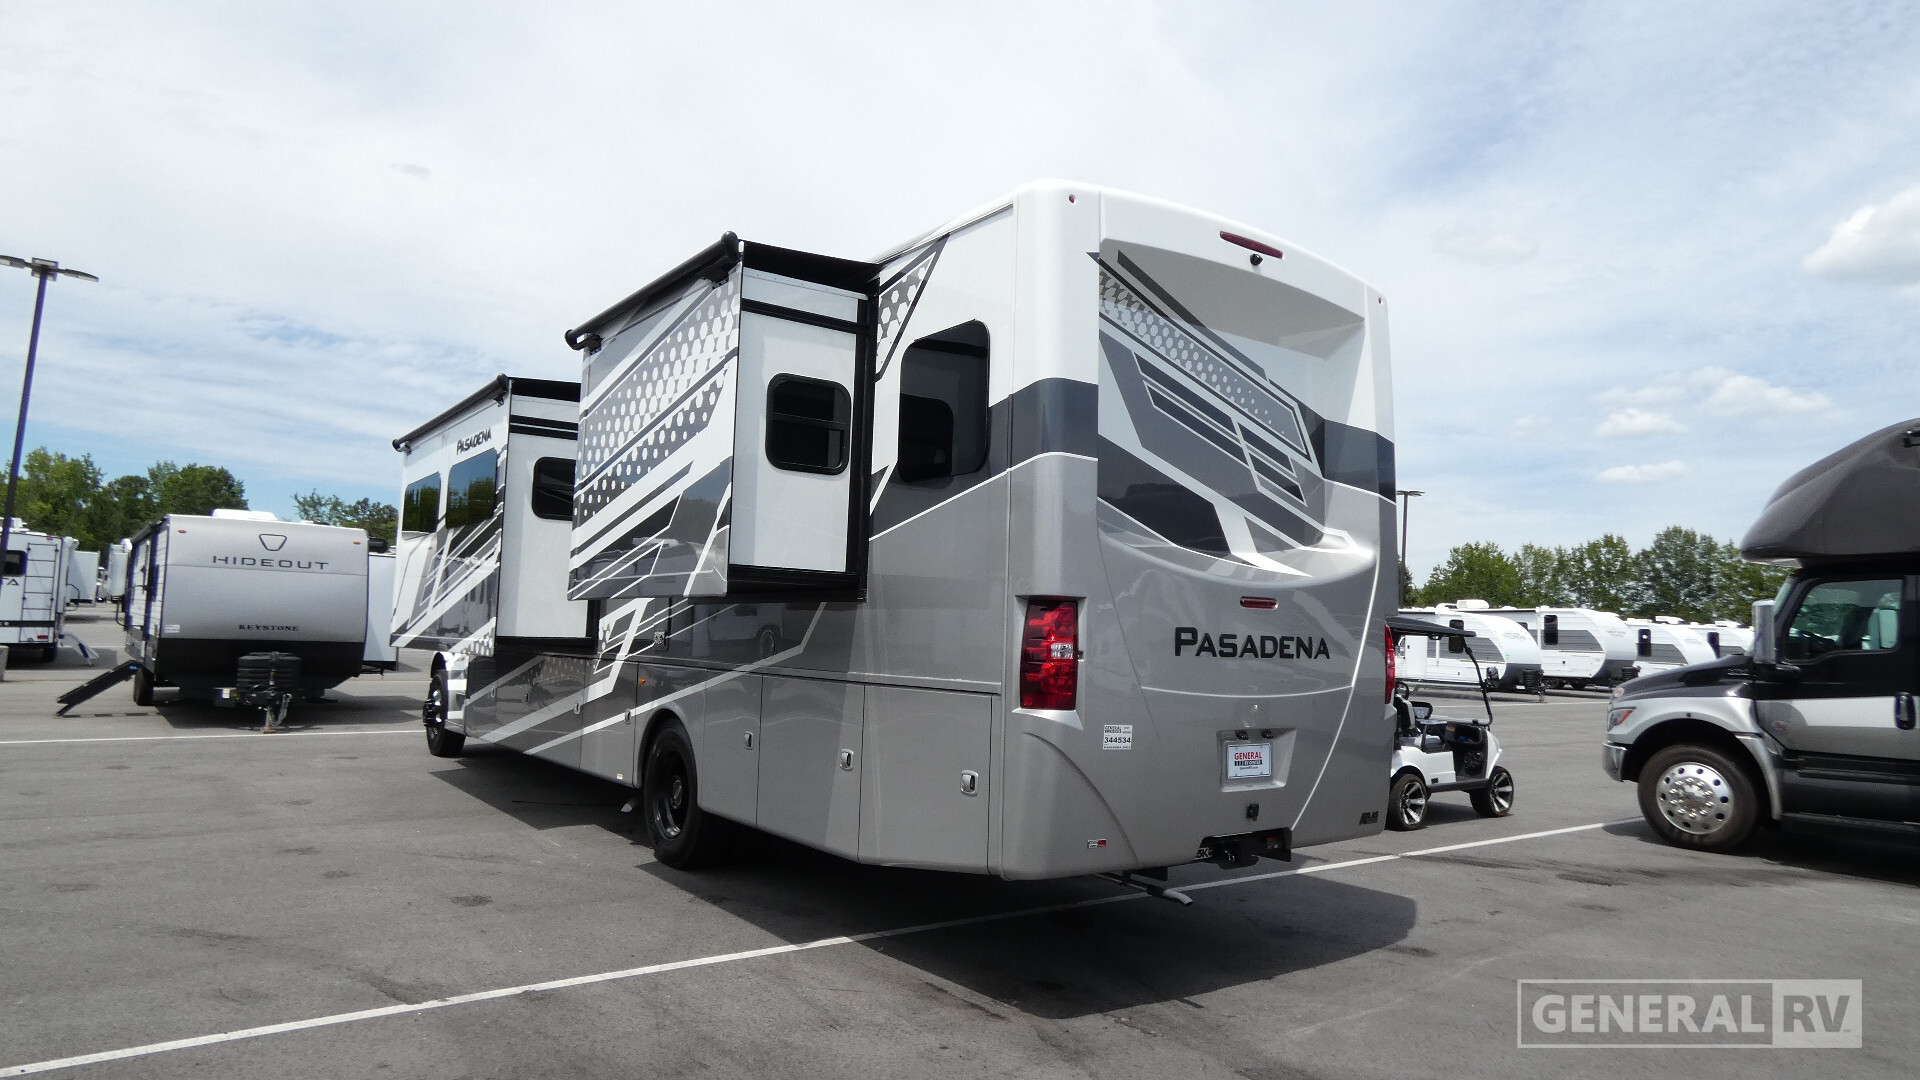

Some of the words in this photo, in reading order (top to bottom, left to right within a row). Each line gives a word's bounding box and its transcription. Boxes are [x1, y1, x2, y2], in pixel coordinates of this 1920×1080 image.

[456, 427, 492, 455] PASADENA
[212, 555, 329, 570] HIDEOUT
[238, 624, 300, 632] KEYSTONE
[1174, 626, 1330, 660] PASADENA
[1104, 736, 1131, 744] 344534
[1234, 751, 1262, 760] GENERAL
